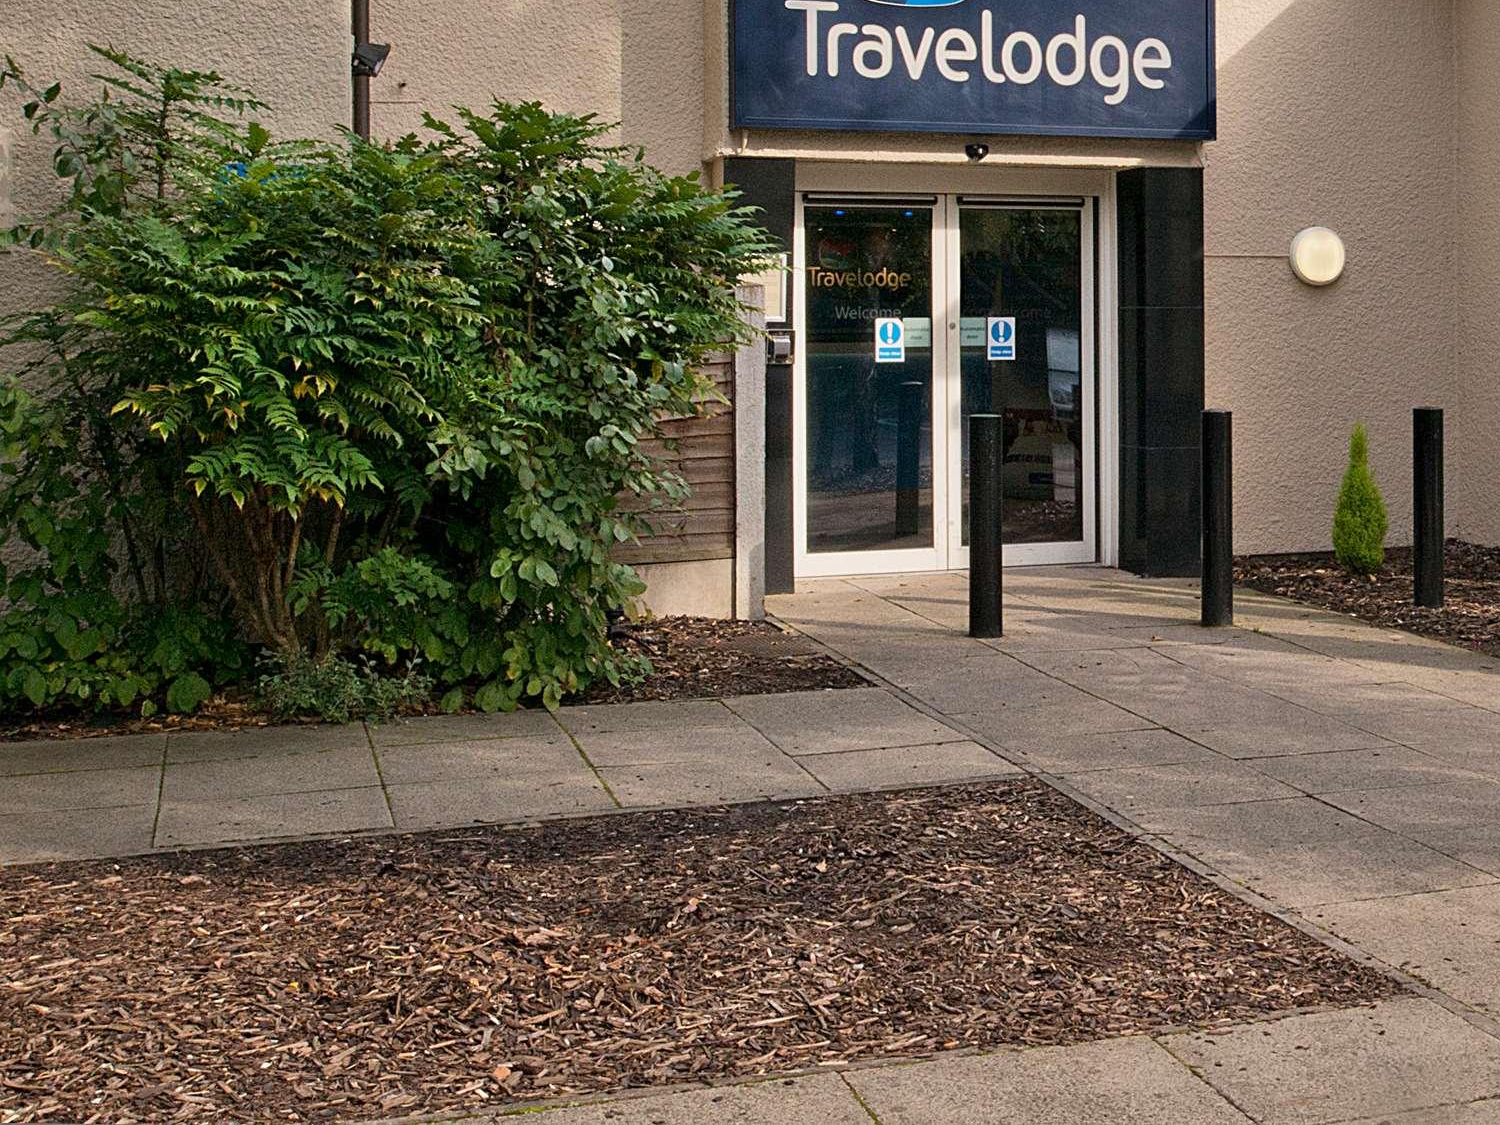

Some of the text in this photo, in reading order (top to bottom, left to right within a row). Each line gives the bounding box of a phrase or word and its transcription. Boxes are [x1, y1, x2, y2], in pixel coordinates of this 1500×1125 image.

[784, 0, 1172, 106] Travelodge
[806, 266, 912, 291] Travelodge
[834, 306, 902, 319] Welcome
